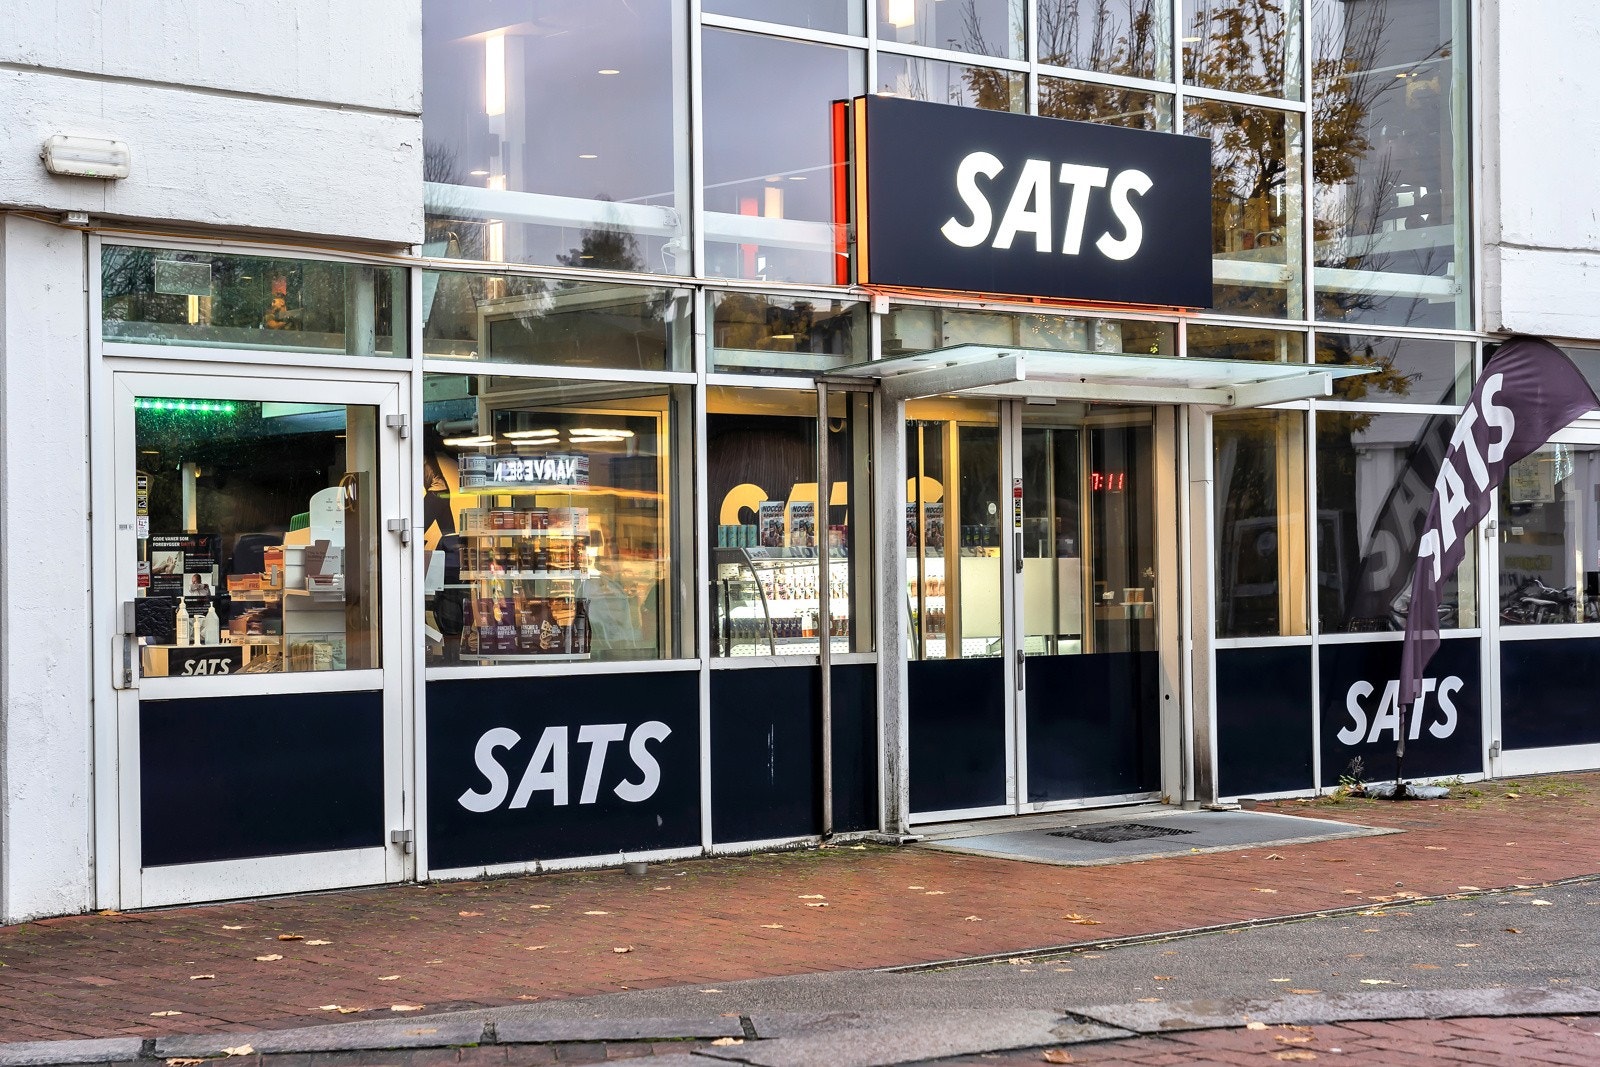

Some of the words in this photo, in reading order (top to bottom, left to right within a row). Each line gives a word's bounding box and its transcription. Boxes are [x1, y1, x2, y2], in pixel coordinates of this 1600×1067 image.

[941, 152, 1153, 261] SATS
[1091, 473, 1124, 490] 7:11
[181, 658, 232, 676] SATS
[1337, 675, 1464, 746] SATS
[457, 720, 672, 813] SATS
